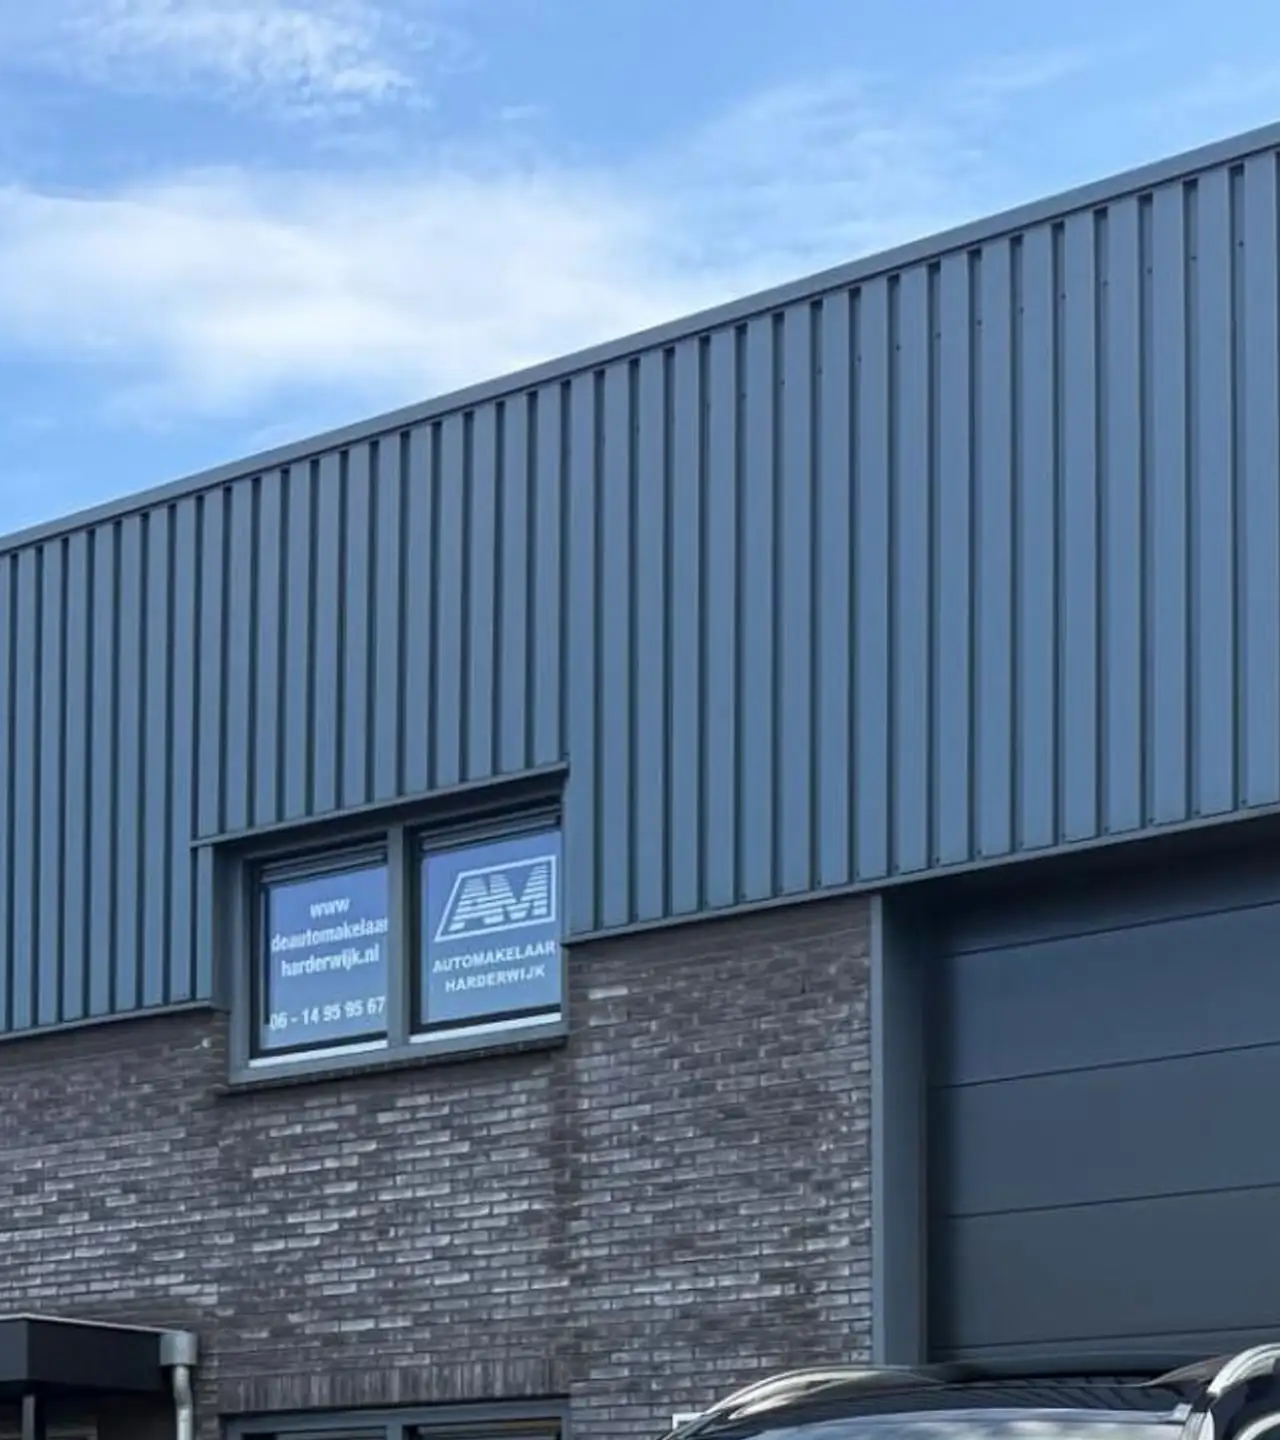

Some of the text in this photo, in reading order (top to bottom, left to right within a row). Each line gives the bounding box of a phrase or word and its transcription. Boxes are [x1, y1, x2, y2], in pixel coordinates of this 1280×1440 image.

[310, 898, 350, 918] www
[281, 944, 380, 977] harderwijk.nl
[432, 940, 555, 974] AUTOMAKELAAR
[445, 963, 545, 993] HARDERWIJK
[270, 1012, 288, 1031] 06
[301, 1007, 319, 1025] 14
[367, 996, 386, 1014] 67
